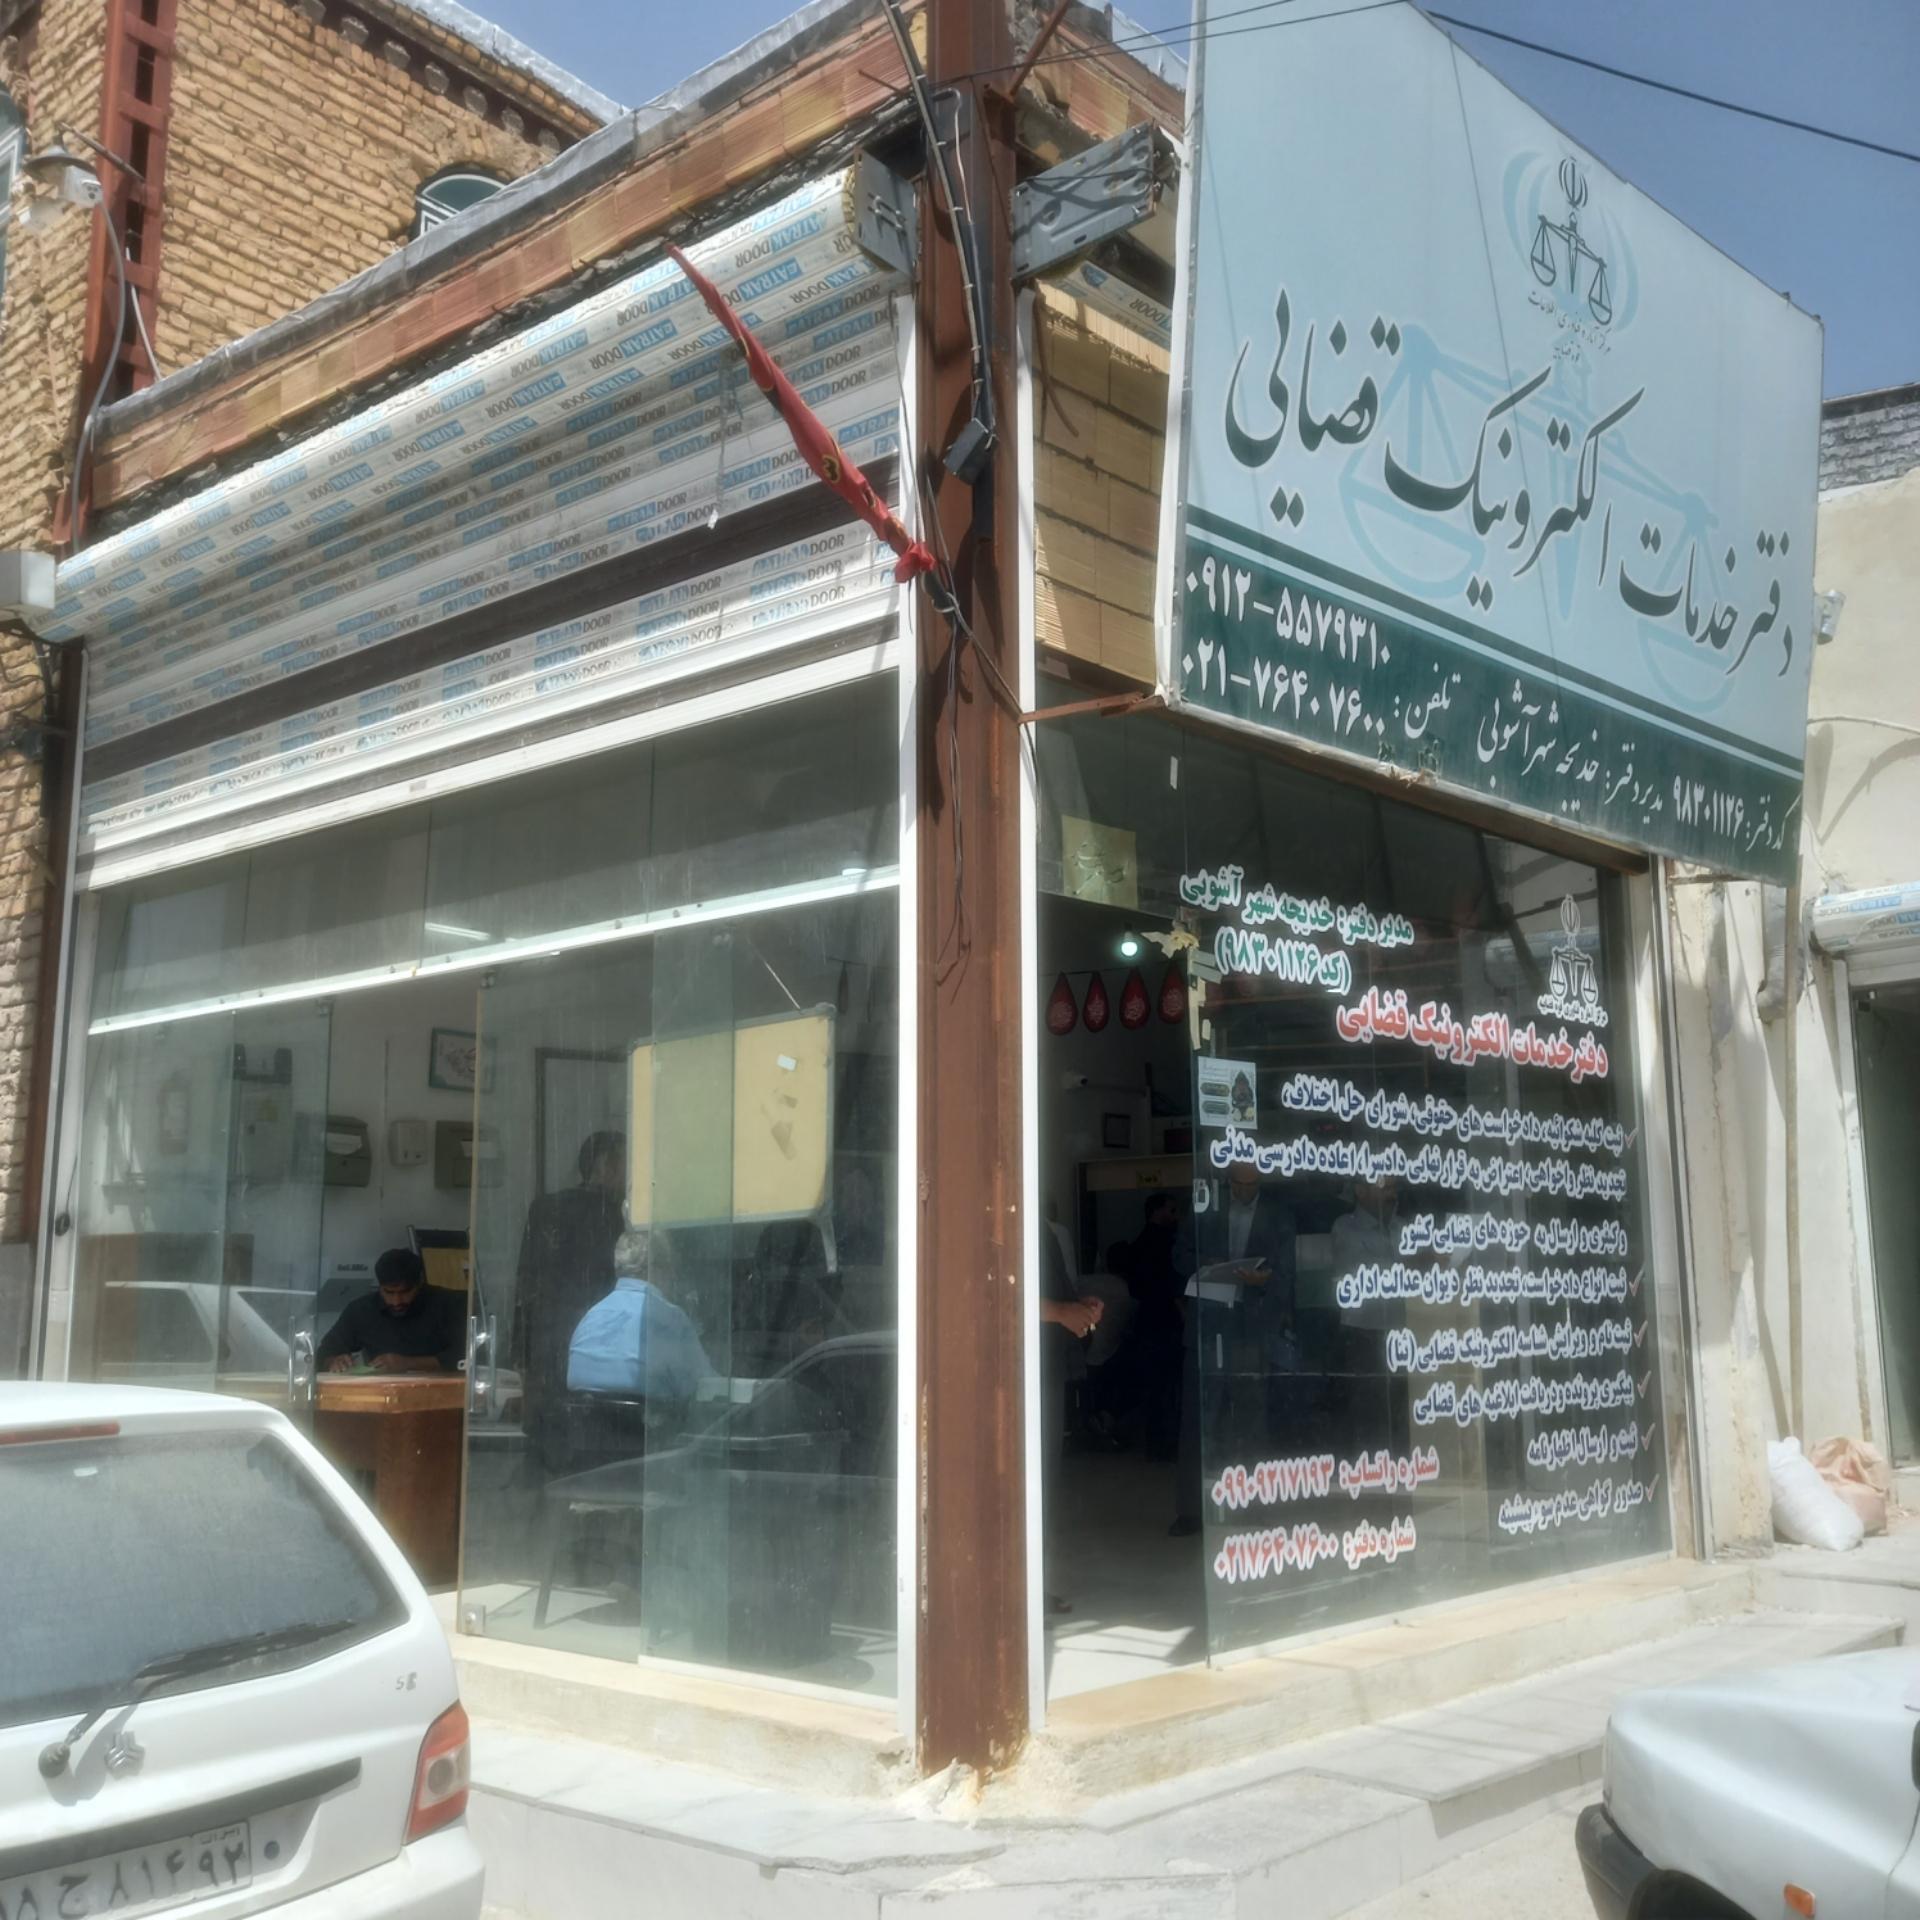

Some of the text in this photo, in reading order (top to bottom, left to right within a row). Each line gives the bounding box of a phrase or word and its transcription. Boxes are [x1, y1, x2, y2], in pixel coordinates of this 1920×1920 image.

[734, 237, 771, 268] DOOR
[742, 260, 802, 301] ATRAK
[790, 282, 830, 305] DOOR
[616, 302, 649, 327] DOOR
[588, 343, 623, 372] DOOR
[621, 320, 678, 357] ATRAK
[667, 335, 705, 361] DOOR
[825, 345, 862, 370] DOOR
[511, 354, 540, 378] DOOR
[485, 394, 516, 419] DOOR
[513, 373, 566, 408] ATRAK
[415, 402, 442, 424] DOOR
[600, 370, 867, 489] DOOR DOOR
[392, 440, 419, 463] DOOR
[722, 455, 772, 490] ATRAK
[1225, 287, 1793, 678] دفتر خدمات الکترونیک قضایی
[656, 490, 688, 514] DOOR
[552, 532, 582, 552] DOOR
[579, 544, 609, 564] DOOR
[483, 580, 510, 600] DOOR
[582, 533, 845, 634] DOOR DOOR DOOR
[687, 559, 843, 624] DOOR DOOR
[810, 585, 846, 610] DOOR
[1186, 555, 1391, 671] ۰۹۱۲-۵۵۷۹۳۱۰
[1181, 636, 1386, 736] ۰۲۱-۷۶۴۰۷۶۰۰
[1556, 728, 1600, 812] خدیجه
[1638, 782, 1663, 824] مدیر
[1673, 775, 1745, 839] ۹۸۳۰۱۱۲۶
[1770, 794, 1801, 851] کد
[1276, 895, 1335, 935] خدیجه
[1337, 902, 1378, 946] دفتر:
[1378, 913, 1414, 947] مدیر
[1336, 985, 1608, 1083] دفتر خدمات الکترونیک قضایی
[1338, 1081, 1366, 1122] حل
[1365, 1088, 1410, 1131] شورای
[1210, 1124, 1257, 1169] مدنی
[1583, 1117, 1604, 1152] کلیه
[1603, 1122, 1623, 1157] ثبت
[1255, 1134, 1318, 1177] دادرسی
[1317, 1139, 1357, 1177] اعاده
[1406, 1143, 1442, 1184] نهایی
[1440, 1148, 1468, 1190] قرار
[1467, 1156, 1483, 1190] به
[1481, 1155, 1525, 1197] اعتراض
[1576, 1162, 1597, 1200] نظر
[1595, 1169, 1627, 1202] تجدید
[1398, 1213, 1434, 1255] کشور
[1432, 1213, 1474, 1254] قضایی
[1474, 1211, 1500, 1250] های
[1500, 1218, 1531, 1251] حوزه
[1534, 1222, 1549, 1254] به
[1549, 1217, 1579, 1256] ارسال
[1589, 1218, 1621, 1254] کیفری
[1336, 1264, 1381, 1308] اداری
[1380, 1263, 1423, 1301] عدالت
[1422, 1262, 1460, 1304] دیوان
[1460, 1265, 1485, 1307] نظر
[1485, 1265, 1522, 1304] تجدید
[1580, 1266, 1608, 1304] انواع
[1606, 1265, 1628, 1305] ثبت
[1416, 1328, 1457, 1372] قضایی
[1457, 1325, 1517, 1368] الکترونیک
[1548, 1321, 1588, 1361] ویرایش
[1598, 1318, 1614, 1352] نام
[1613, 1316, 1633, 1356] ثبت
[1414, 1380, 1456, 1424] قضایی
[1455, 1384, 1485, 1427] های
[1484, 1379, 1520, 1422] ابلاغیه
[1519, 1375, 1557, 1414] دریافت
[1565, 1372, 1600, 1410] پرونده
[1599, 1369, 1634, 1406] پیگیری
[1577, 1424, 1608, 1466] ارسال
[1609, 1434, 1618, 1462] و
[1618, 1421, 1638, 1460] ثبت
[1339, 1448, 1398, 1500] واتساپ:
[1398, 1445, 1440, 1492] شماره
[1498, 1493, 1534, 1535] پیشینه
[1554, 1489, 1578, 1527] عدم
[1578, 1478, 1612, 1521] گواهی
[1613, 1479, 1643, 1513] صدور
[1343, 1518, 1379, 1570] دفتر:
[1378, 1515, 1416, 1563] شماره
[199, 1842, 245, 1887] ۹۲
